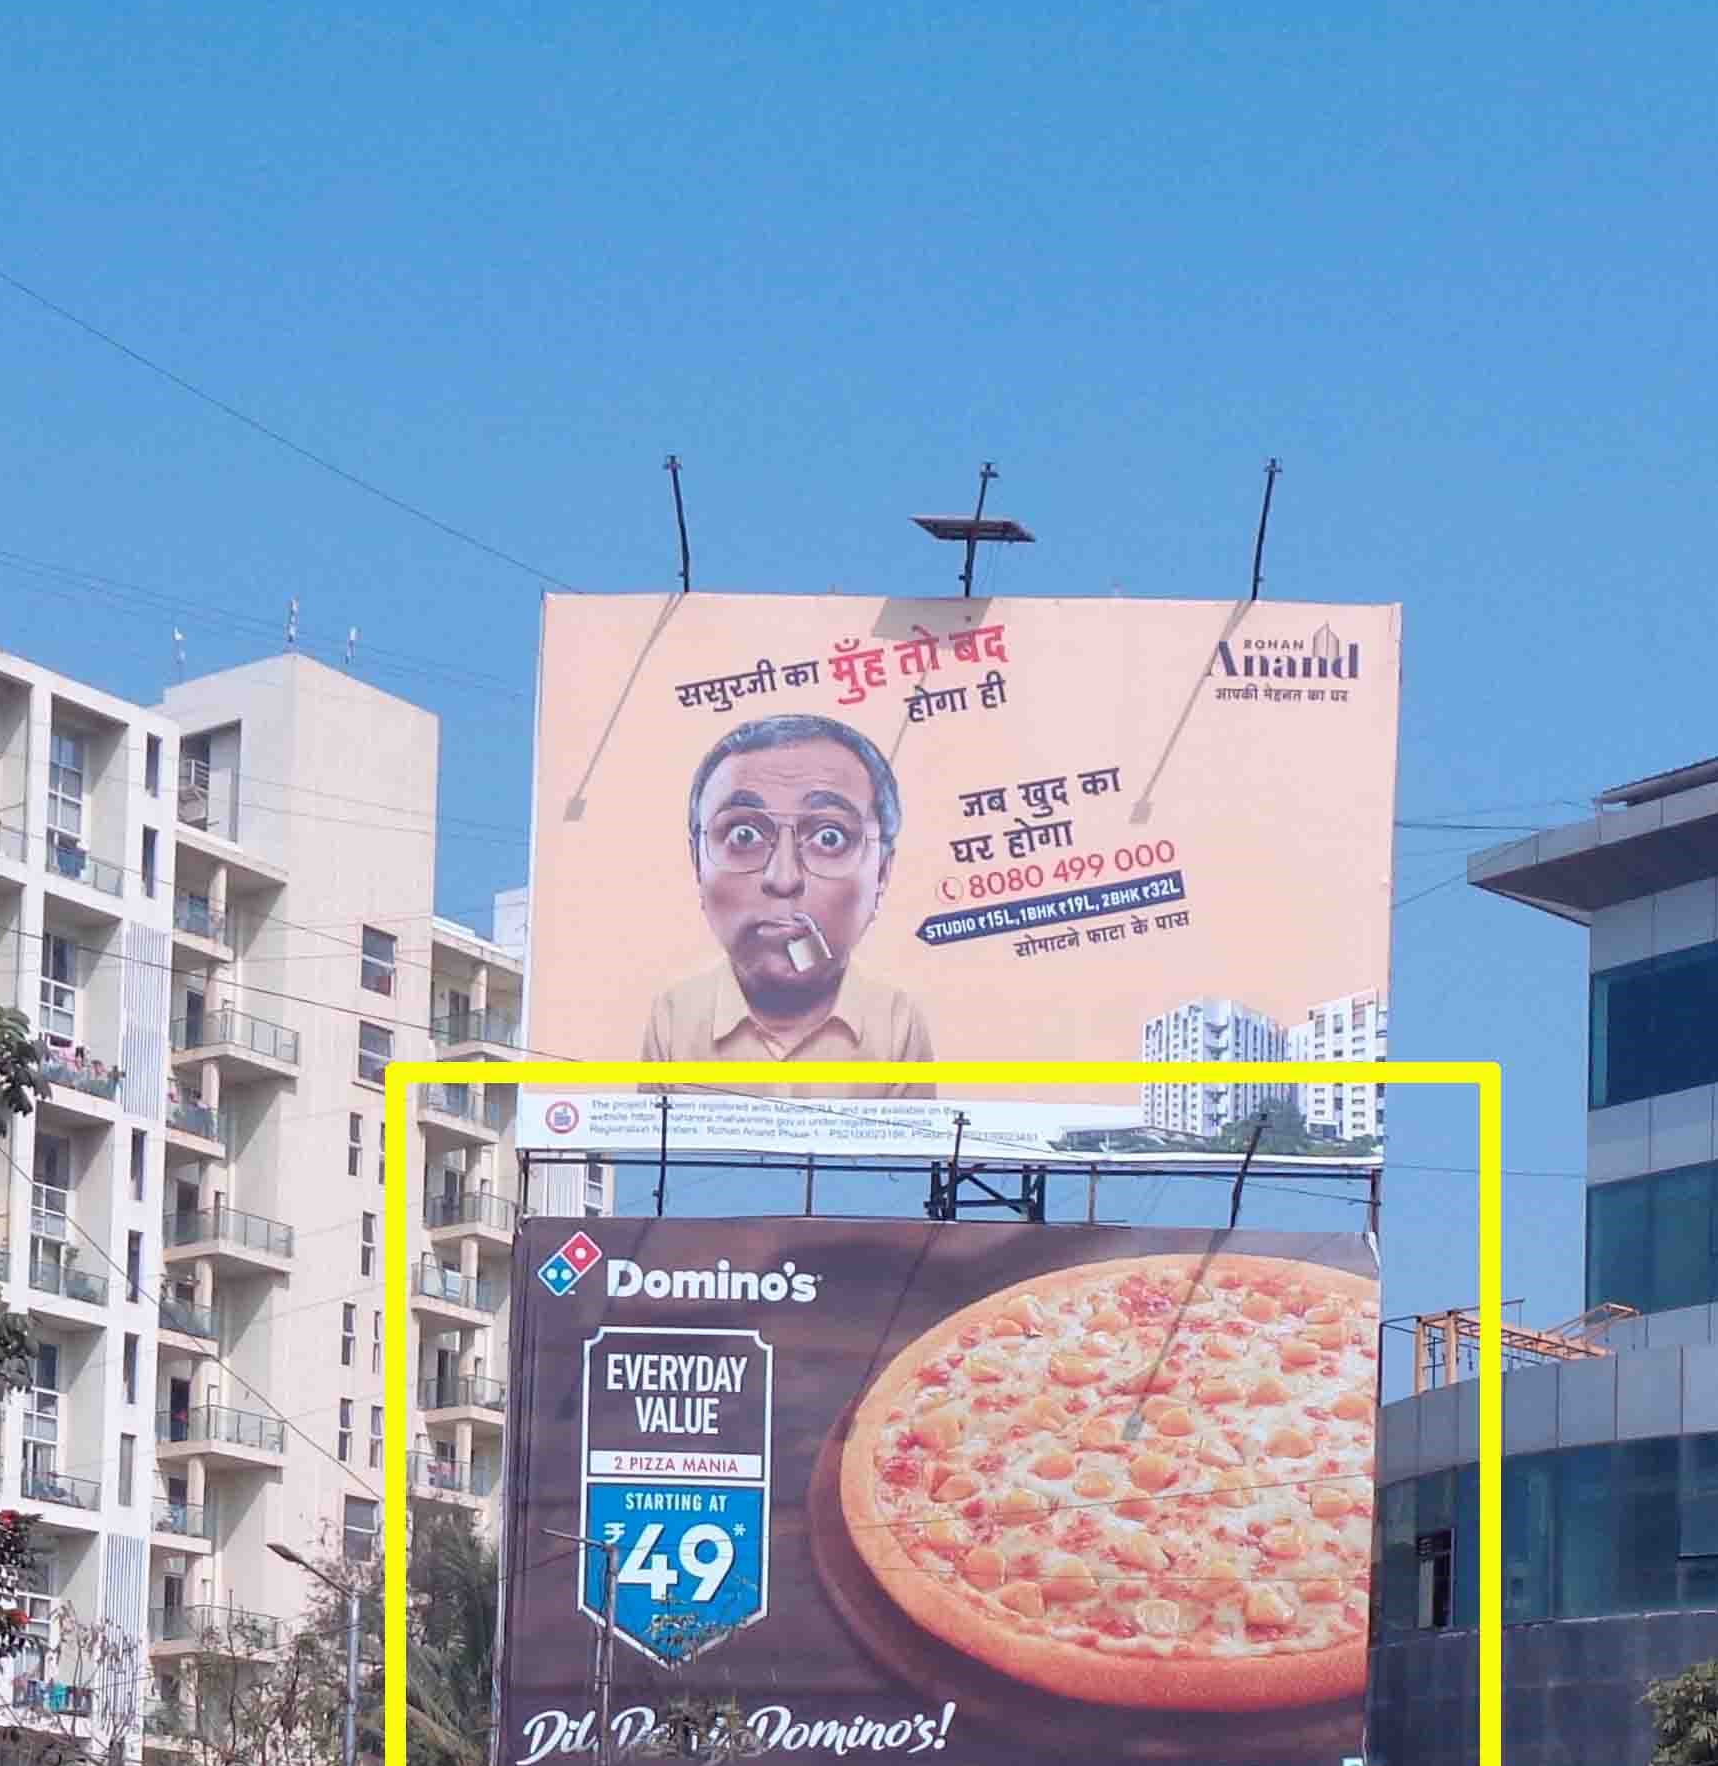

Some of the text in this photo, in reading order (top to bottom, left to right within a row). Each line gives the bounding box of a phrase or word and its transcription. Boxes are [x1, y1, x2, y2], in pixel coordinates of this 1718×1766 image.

[675, 615, 1008, 712] ससुरजी का मुँह तो बंद
[1205, 641, 1358, 679] Anand
[1244, 639, 1304, 650] ROHAN
[904, 671, 1008, 722] होगा ही
[959, 767, 1120, 817] जब खुद का
[949, 818, 1073, 863] घर होगा
[969, 840, 1175, 899] 8080 499 000
[925, 917, 976, 940] STUDIO
[1102, 886, 1140, 908] 2BHK
[1131, 915, 1149, 936] के
[1155, 911, 1190, 930] पास
[607, 1258, 819, 1303] Domino's
[606, 1353, 748, 1393] EVERYDAY
[634, 1396, 720, 1435] VALUE
[613, 1456, 738, 1474] 2 PIZZA MANIA
[625, 1492, 727, 1513] STARTING AT
